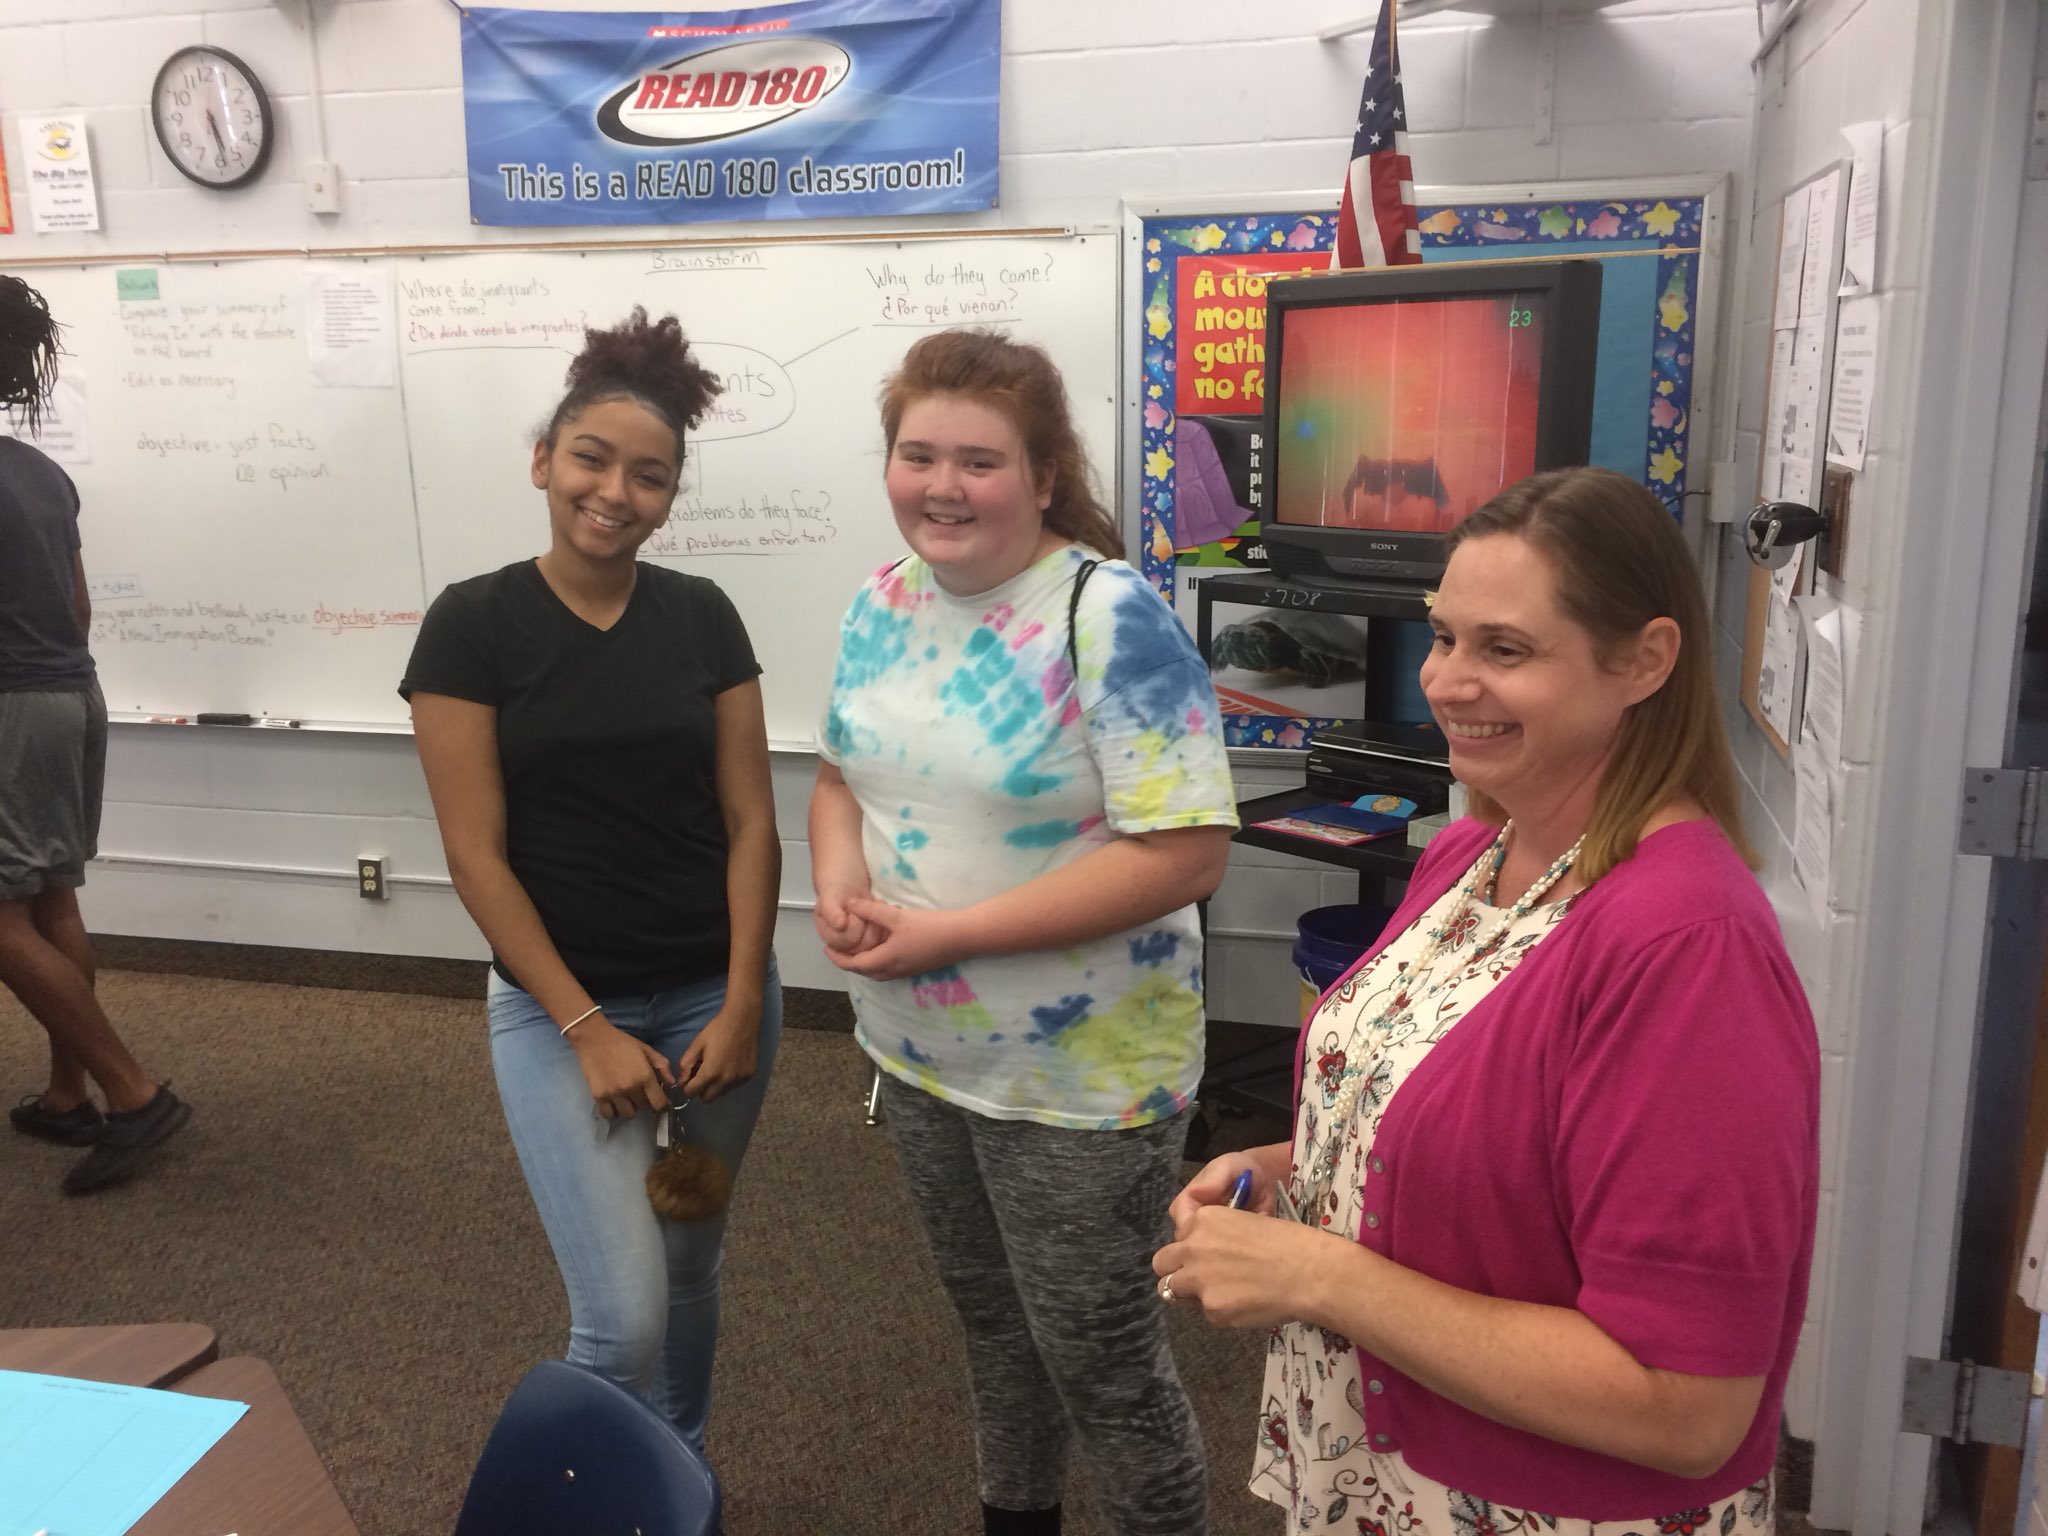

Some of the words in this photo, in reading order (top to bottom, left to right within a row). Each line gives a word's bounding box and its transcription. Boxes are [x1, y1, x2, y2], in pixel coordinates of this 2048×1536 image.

[183, 74, 196, 89] 11
[196, 66, 214, 83] 12
[172, 90, 191, 106] 10
[232, 88, 244, 104] 2
[171, 111, 183, 127] 9
[241, 109, 253, 125] 3
[179, 131, 193, 148] 8
[240, 130, 252, 145] 4
[195, 146, 206, 162] 7
[230, 146, 242, 161] 5
[501, 165, 563, 201] This
[574, 164, 604, 199] is
[609, 171, 626, 198] a
[636, 162, 713, 197] READ
[723, 159, 777, 195] 180
[788, 151, 965, 195] classroom!
[652, 250, 761, 269] Brainstorm
[866, 263, 910, 296] Why
[925, 263, 945, 286] do
[951, 262, 987, 297] they
[999, 252, 1053, 285] come?
[400, 278, 455, 301] Where
[460, 278, 478, 298] do
[1194, 270, 1217, 300] A
[408, 303, 443, 317] come
[882, 296, 918, 321] ¿Por
[924, 297, 950, 323] qué
[1194, 306, 1267, 332] mou
[1509, 309, 1532, 328] 23
[1194, 377, 1236, 400] no
[738, 497, 755, 519] do
[759, 494, 793, 537] they
[686, 533, 751, 555] problemas
[1370, 542, 1399, 551] SONY
[1187, 576, 1198, 590] If
